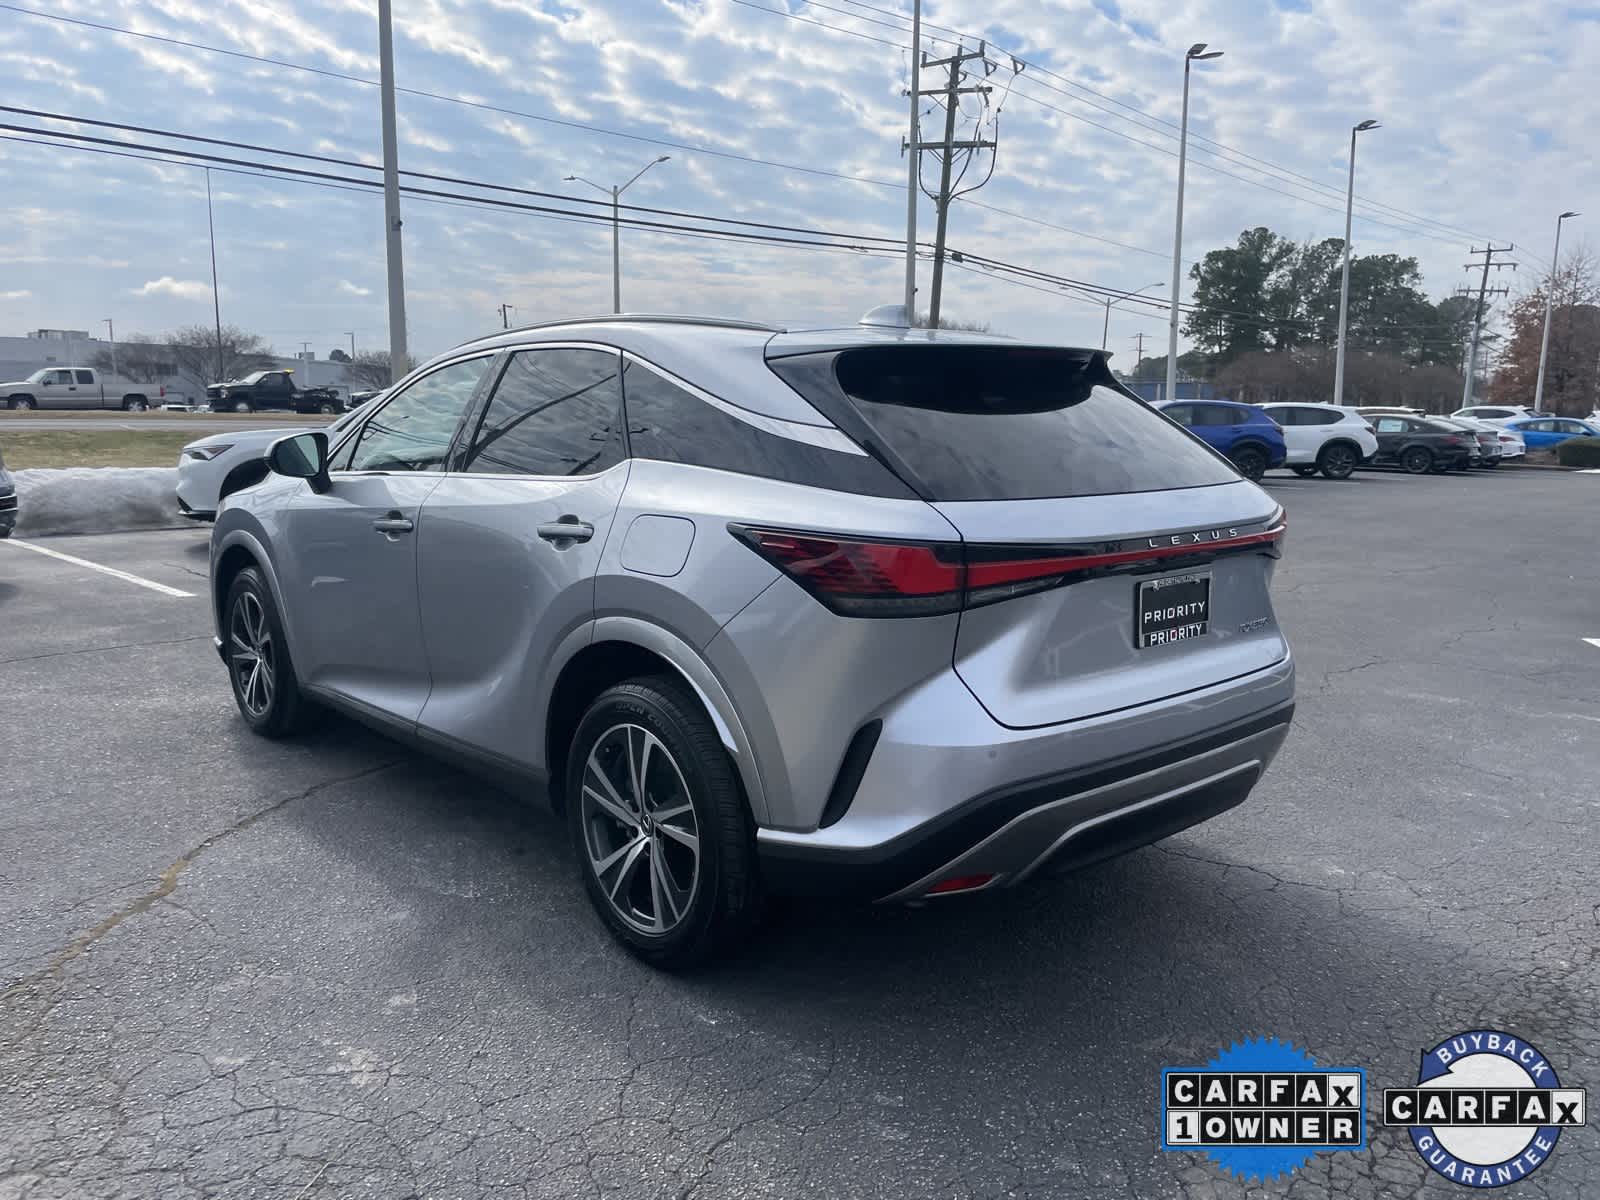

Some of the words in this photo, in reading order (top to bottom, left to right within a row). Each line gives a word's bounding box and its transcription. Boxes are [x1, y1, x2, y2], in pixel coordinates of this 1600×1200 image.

[1148, 528, 1238, 548] LEXUS
[1144, 601, 1205, 624] PRIORITY
[1150, 623, 1202, 646] PRIORITY
